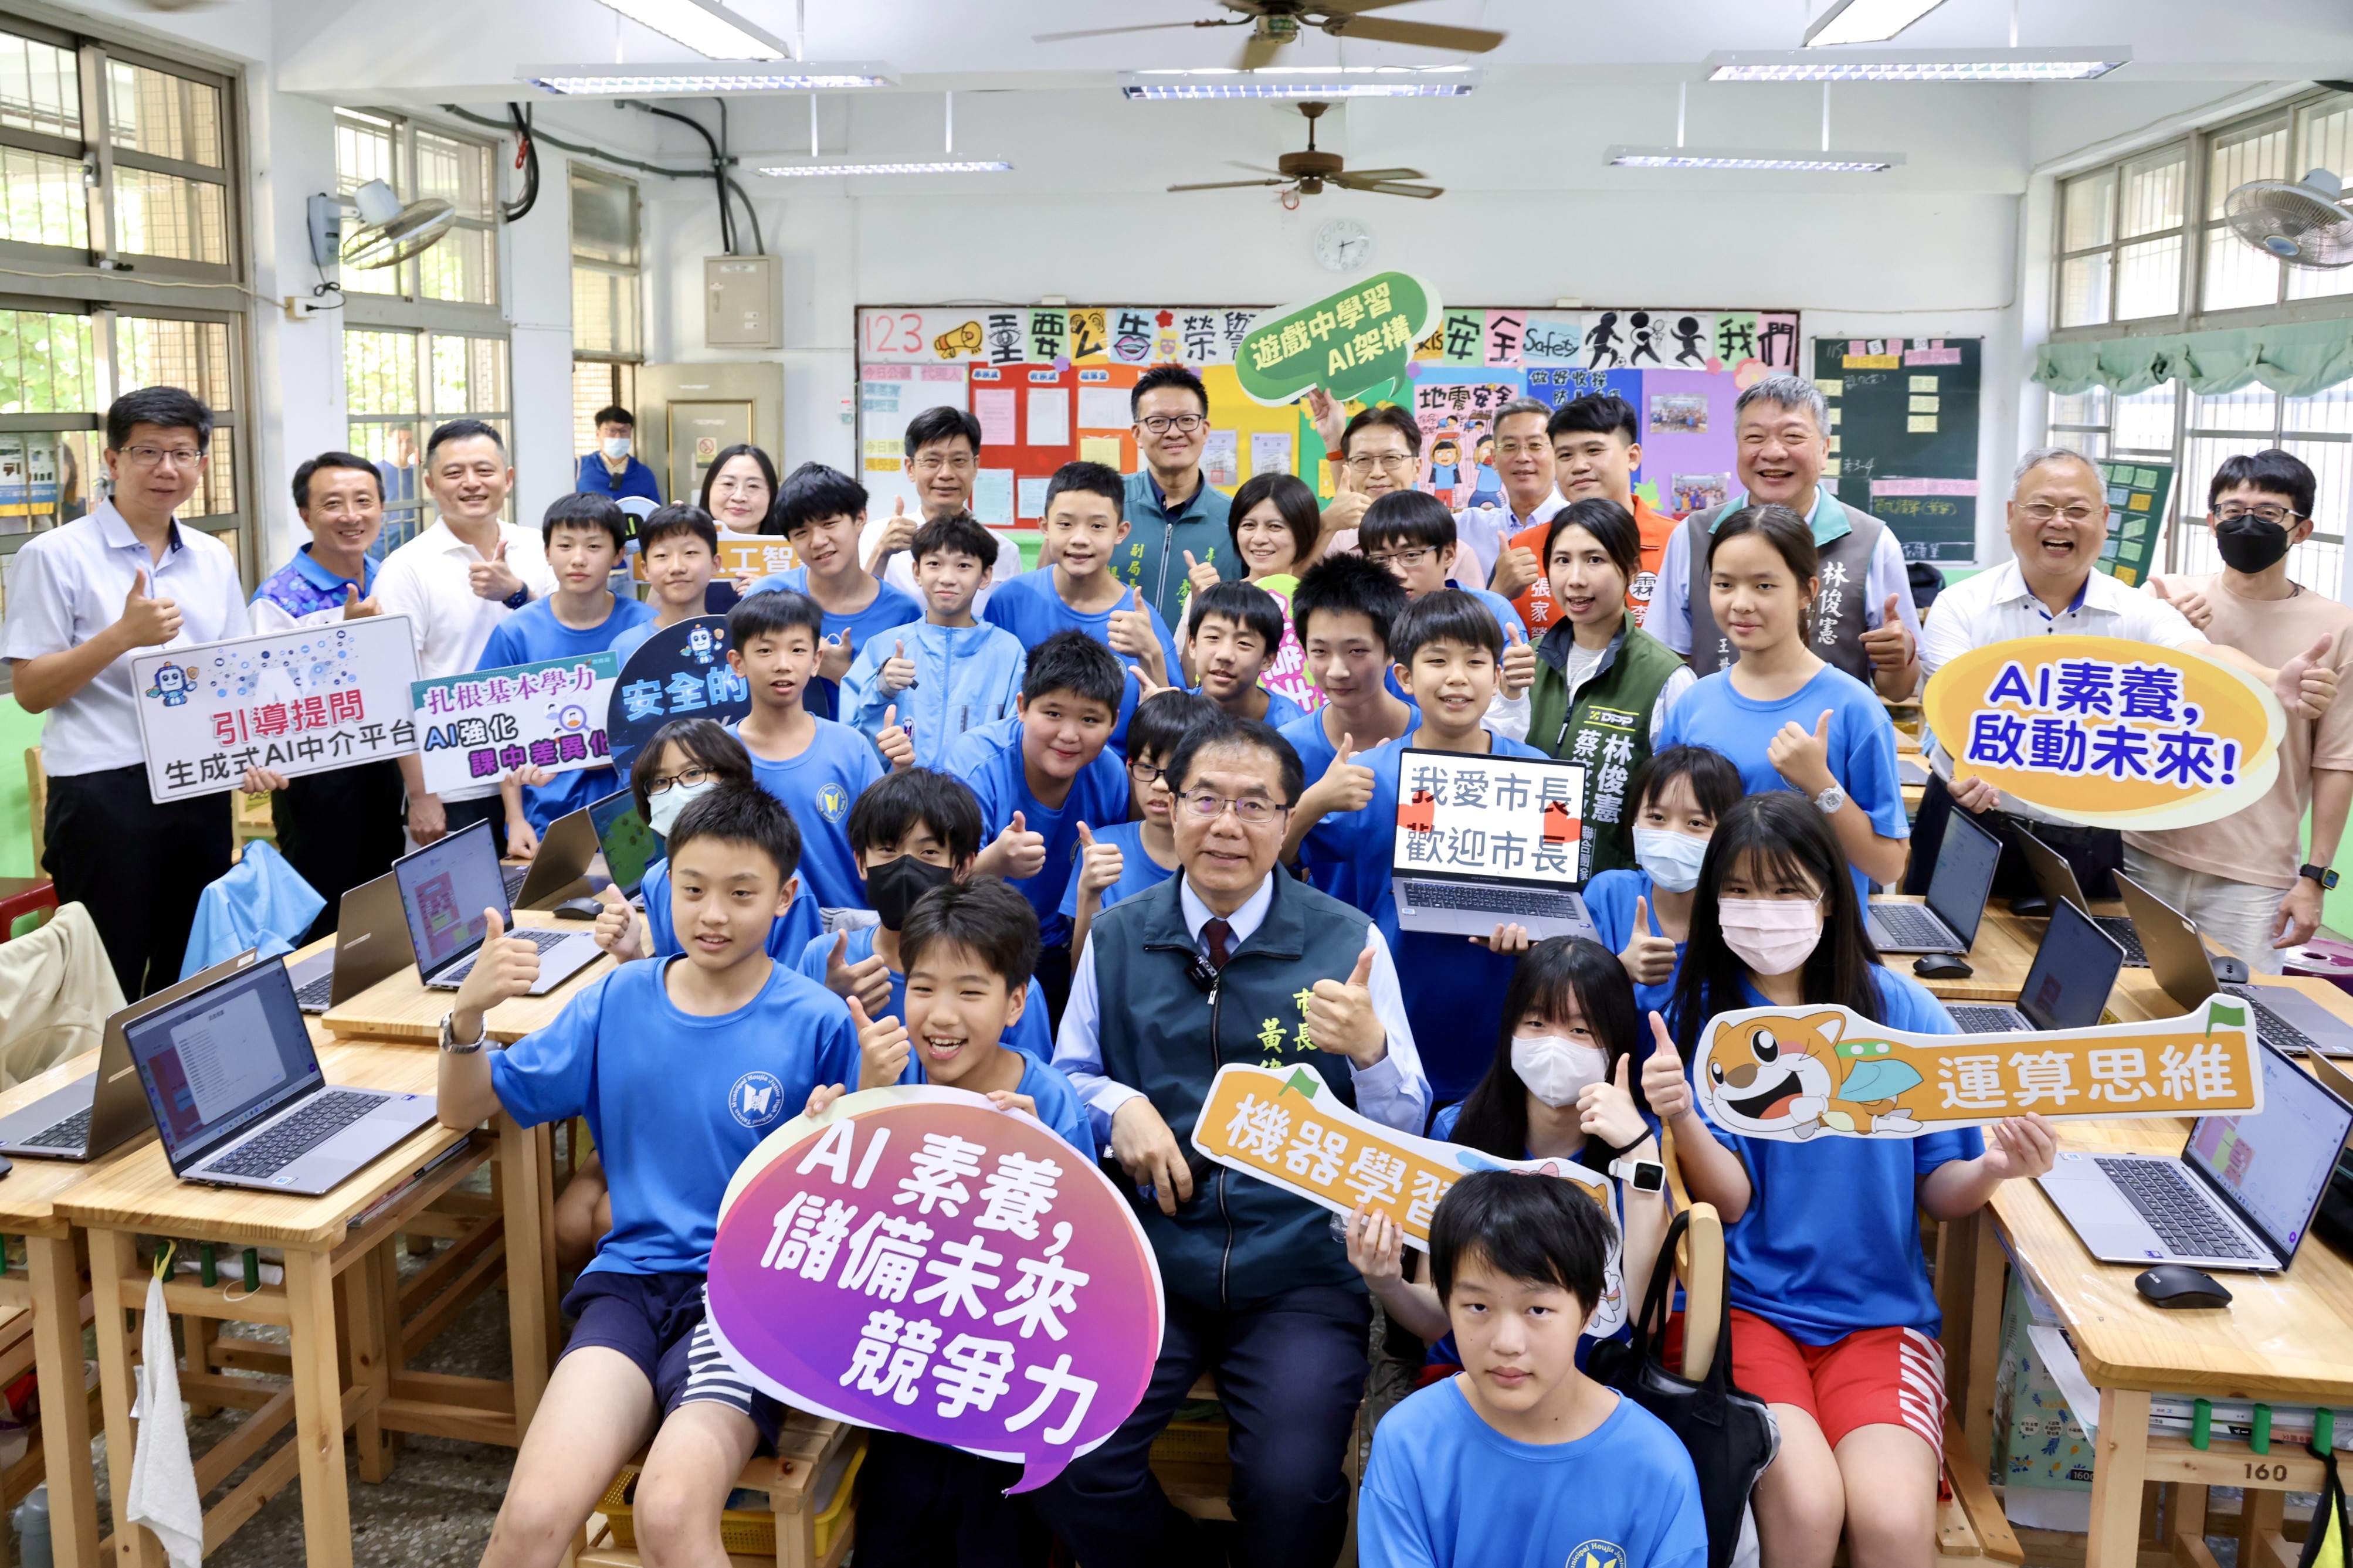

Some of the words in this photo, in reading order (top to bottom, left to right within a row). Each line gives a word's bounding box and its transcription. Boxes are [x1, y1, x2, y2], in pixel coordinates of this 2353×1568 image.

[866, 313, 923, 354] 123
[1250, 281, 1392, 371] 遊戲中學習
[1328, 314, 1412, 376] AI架構
[1447, 315, 1521, 363] 安全
[1523, 328, 1580, 357] Safety
[1719, 318, 1795, 367] 我們
[1915, 340, 1928, 348] 20
[1419, 385, 1513, 411] 地震安全
[864, 441, 905, 453] 今日請
[718, 545, 805, 573] 工智
[1818, 561, 1850, 646] 林俊憲
[426, 665, 596, 715] 扎根基本學力
[622, 663, 749, 722] 安全的
[212, 688, 365, 746] 引導提問
[423, 714, 518, 752] AI強化
[1600, 712, 1633, 725] DPP
[165, 718, 415, 790] 生成式AI中介平台
[469, 729, 611, 779] 課中差異化
[1969, 714, 2236, 785] 啟動未來!
[1410, 766, 1572, 816] 我愛市長
[1591, 733, 1635, 824] 林俊憲
[1406, 822, 1569, 874] 歡迎市長
[1937, 1042, 2237, 1109] 運算思維
[795, 1118, 891, 1190] AI
[1226, 1092, 1462, 1230] 機器學習
[760, 1190, 1090, 1342] 儲備未來
[839, 1309, 1098, 1445] 競爭力
[2244, 1463, 2288, 1482] 160
[1591, 1543, 1615, 1553] Houjia
